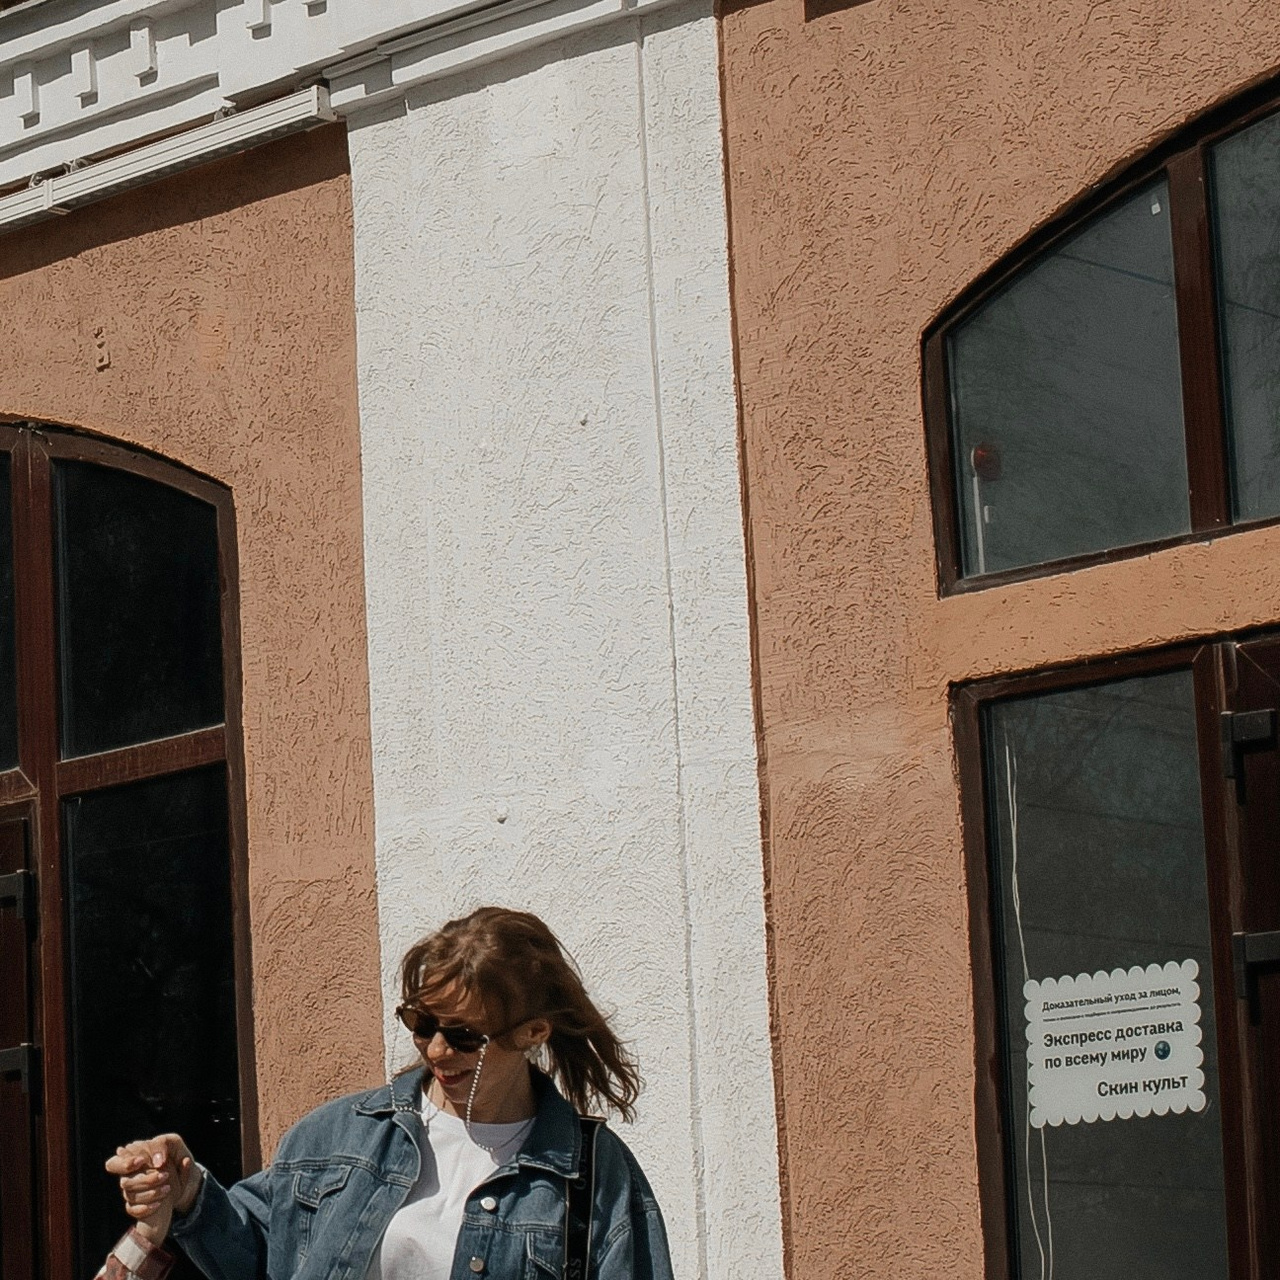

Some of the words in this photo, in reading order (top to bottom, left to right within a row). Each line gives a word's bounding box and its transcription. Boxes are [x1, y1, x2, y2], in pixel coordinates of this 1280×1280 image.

[1042, 993, 1113, 1013] Доказательный
[1114, 992, 1136, 1004] уход
[1138, 991, 1148, 999] за
[1149, 987, 1181, 998] лицом,
[1043, 1028, 1112, 1048] Экспресс
[1114, 1020, 1183, 1042] доставка
[1045, 1056, 1062, 1069] по
[1065, 1050, 1108, 1067] всему
[1111, 1046, 1147, 1064] миру
[1097, 1080, 1139, 1097] Скин
[1142, 1075, 1188, 1095] культ
